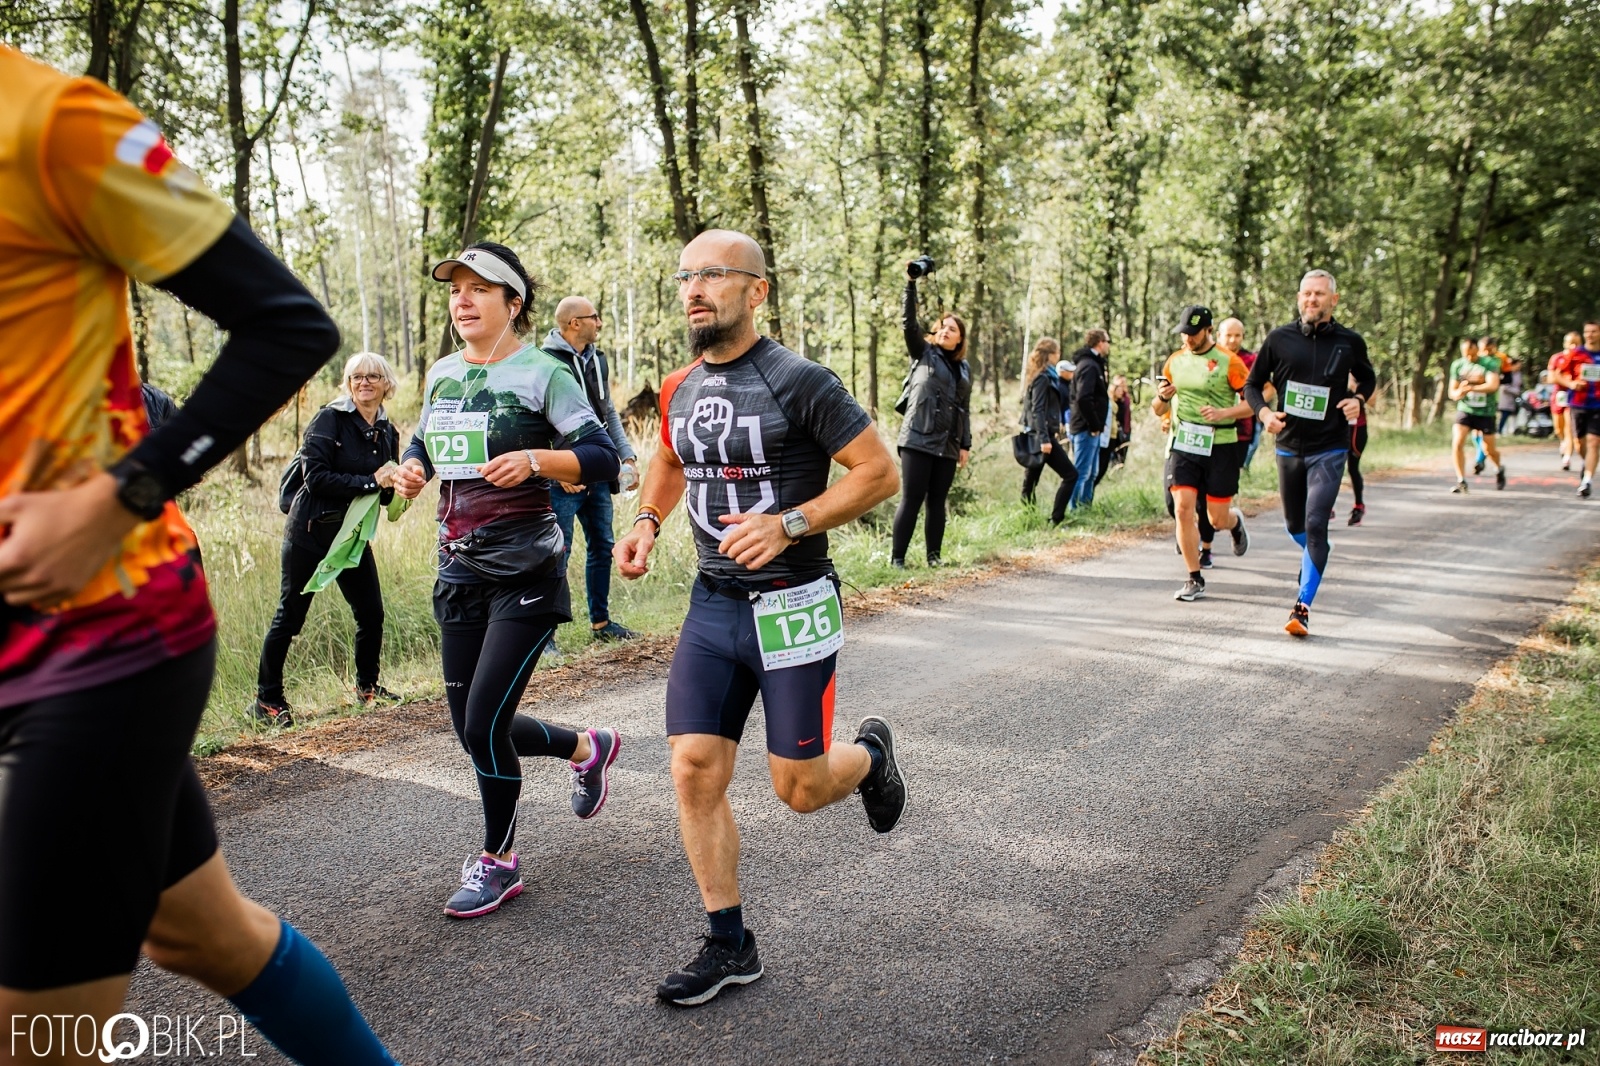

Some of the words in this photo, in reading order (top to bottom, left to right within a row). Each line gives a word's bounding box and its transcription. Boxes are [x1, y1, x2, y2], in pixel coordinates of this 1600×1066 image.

[1295, 394, 1315, 410] 58
[1183, 432, 1205, 447] 154
[430, 435, 469, 462] 129
[706, 467, 714, 478] &
[777, 593, 786, 610] V
[775, 604, 832, 647] 126
